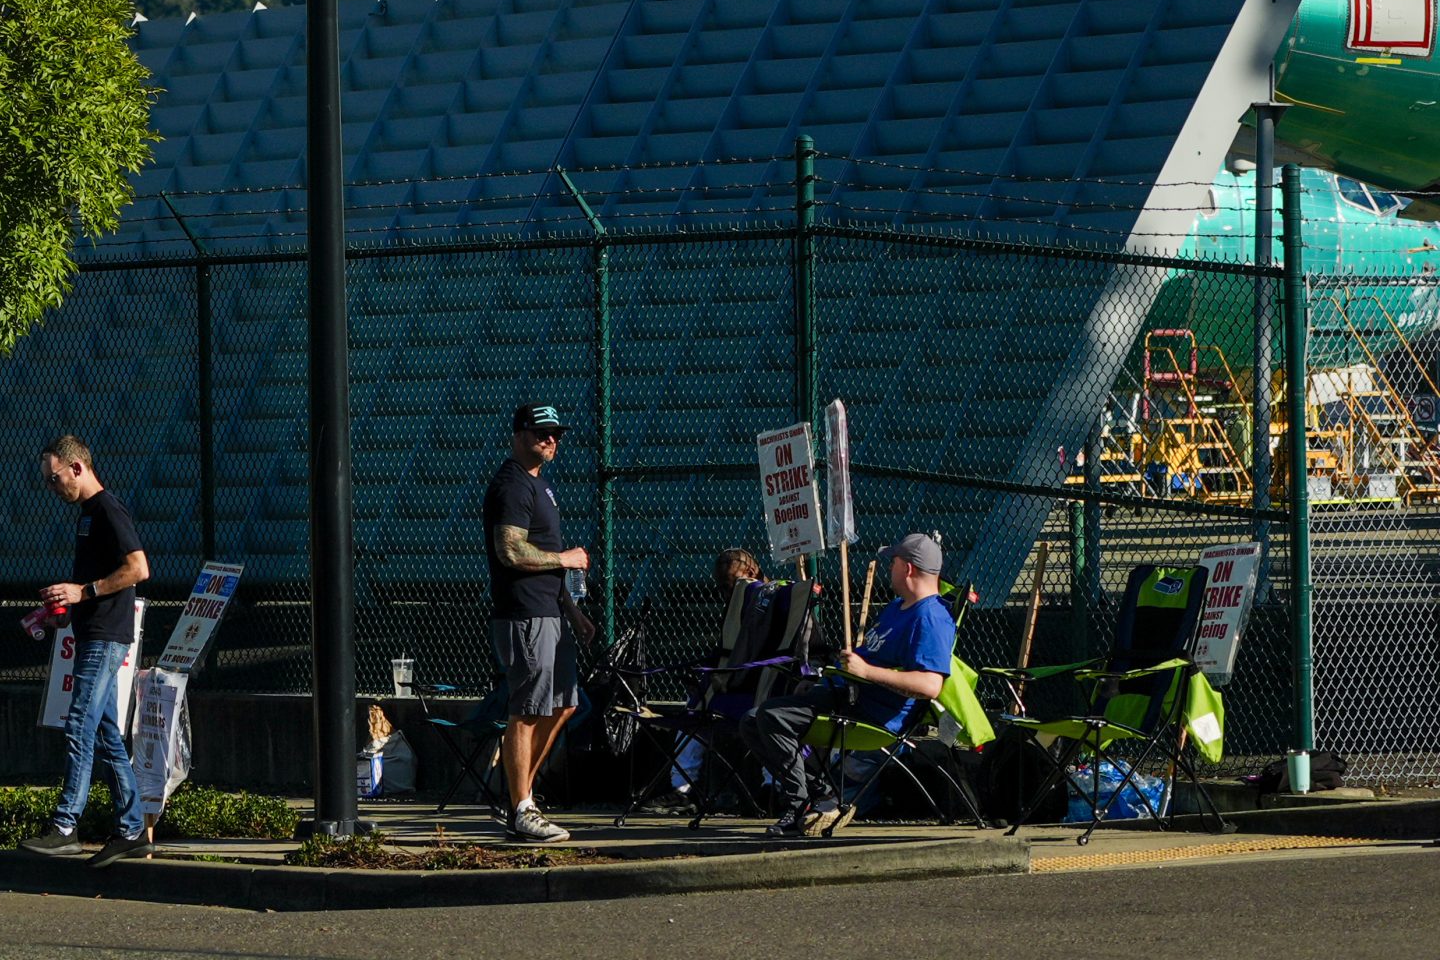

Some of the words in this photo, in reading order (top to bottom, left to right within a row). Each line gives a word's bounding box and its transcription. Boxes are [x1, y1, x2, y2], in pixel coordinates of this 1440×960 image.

[759, 431, 789, 446] MACHINISTS
[775, 442, 793, 467] ON
[765, 464, 810, 496] STRIKE
[778, 492, 800, 505] AGAINST
[773, 503, 809, 525] Boeing
[1203, 549, 1235, 559] MACHINISTS
[1236, 547, 1255, 556] UNION
[1212, 560, 1234, 583] ON
[206, 575, 224, 594] ON
[1205, 585, 1243, 608] TRIKE
[184, 597, 224, 619] STRIKE
[1203, 611, 1224, 620] GAINST
[1201, 621, 1228, 639] eing
[162, 654, 172, 662] AT
